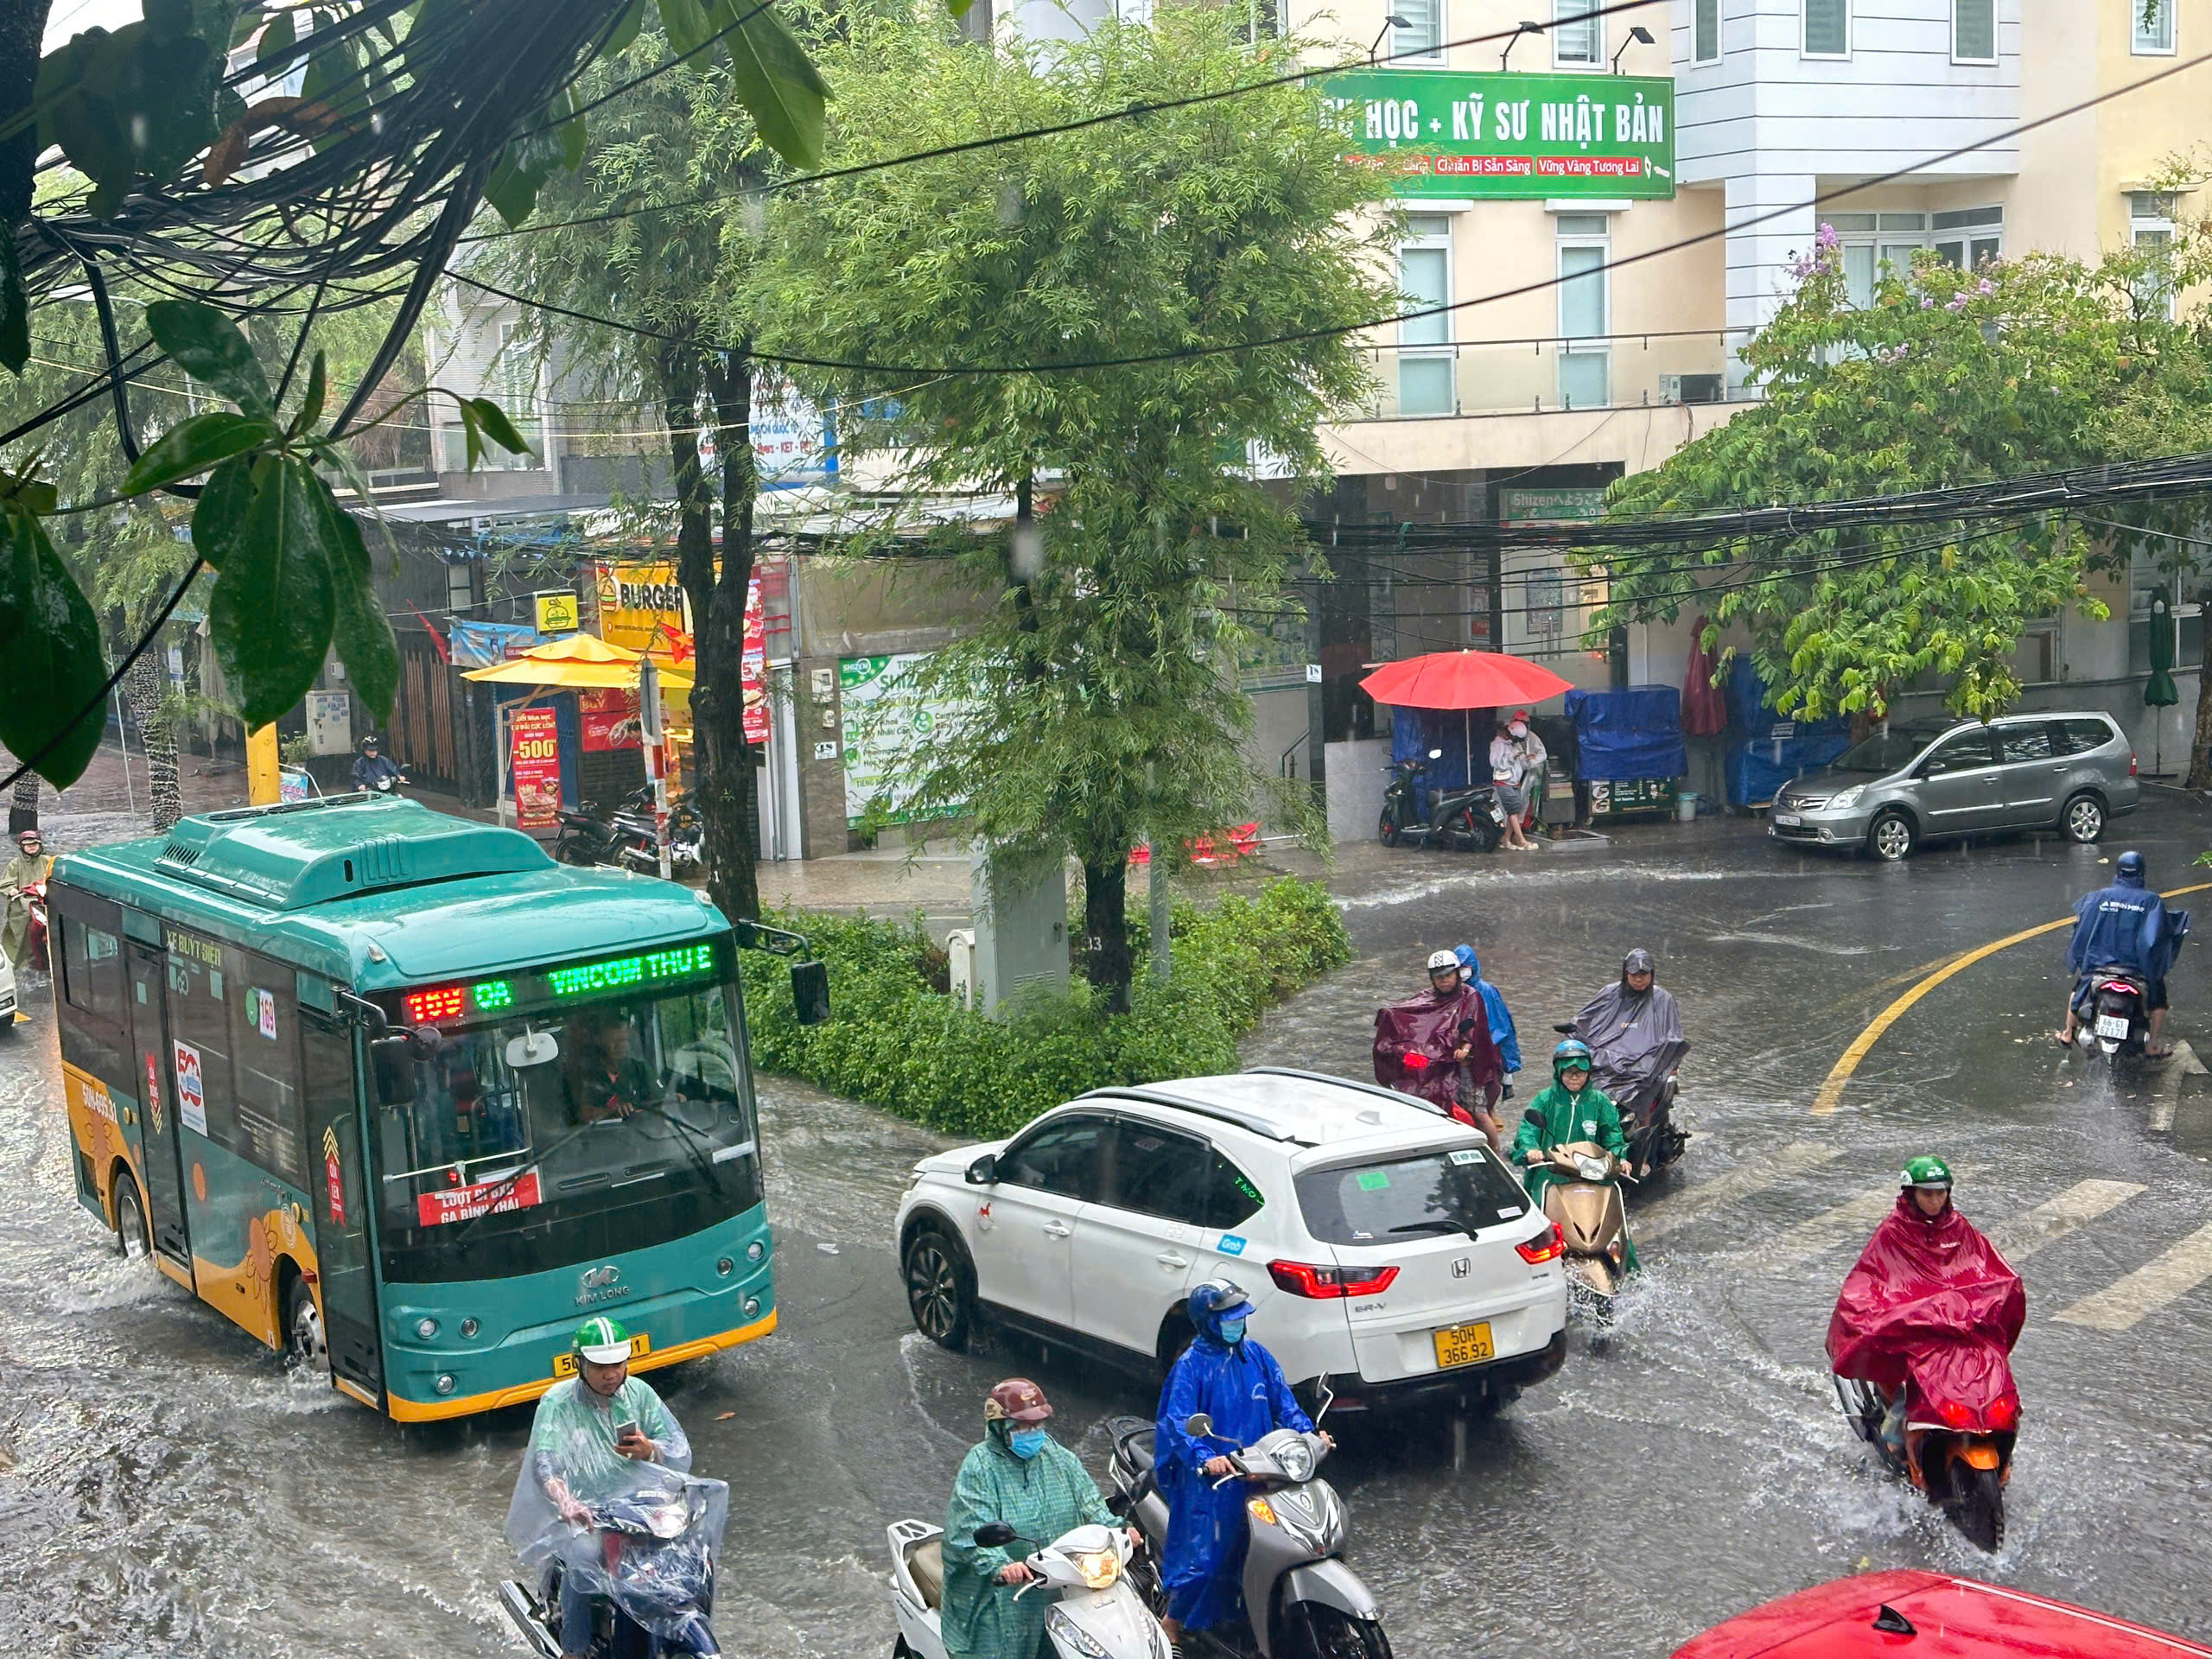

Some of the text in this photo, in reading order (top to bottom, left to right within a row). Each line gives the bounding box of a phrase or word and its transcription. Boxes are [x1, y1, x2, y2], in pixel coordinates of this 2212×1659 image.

[1366, 99, 1418, 148] HỌC
[1452, 92, 1484, 140] KỸ
[1495, 99, 1530, 141] SƯ
[1541, 94, 1605, 149] NHẬT
[1616, 92, 1663, 143] BẢN
[1471, 159, 1483, 175] Bị
[1484, 158, 1503, 172] Sẵn
[1505, 158, 1531, 175] Sàng
[1539, 159, 1639, 176] Vững Vàng Tương Lai
[260, 998, 275, 1032] 169
[441, 1211, 457, 1224] GA
[1221, 1238, 1242, 1252] Grab
[575, 1285, 630, 1307] KIM LONG
[1354, 1302, 1387, 1313] BR-V
[1451, 1327, 1476, 1345] 50H
[1444, 1342, 1488, 1364] 366.92
